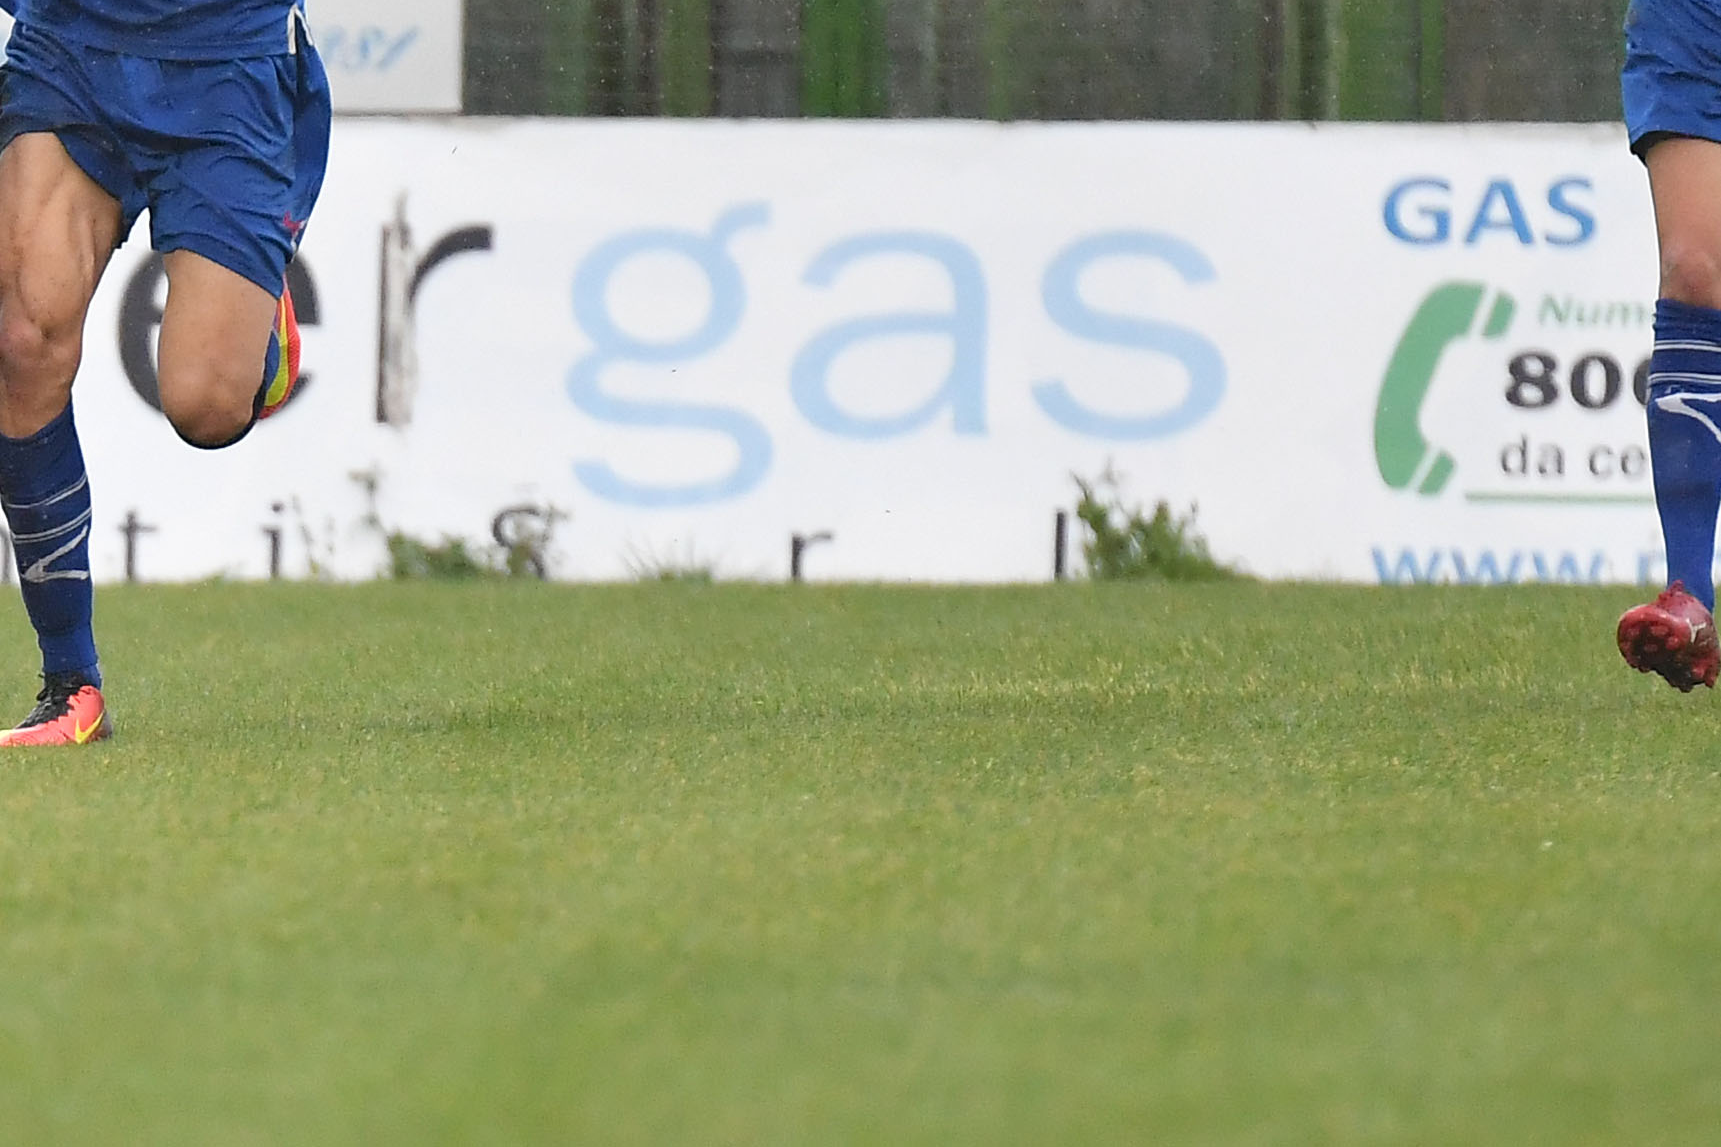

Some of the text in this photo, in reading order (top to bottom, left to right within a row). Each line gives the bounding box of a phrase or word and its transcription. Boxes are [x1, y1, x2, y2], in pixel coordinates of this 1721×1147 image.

[1381, 176, 1597, 246] GAS
[1537, 293, 1654, 328] Num
[1499, 433, 1566, 478] da
